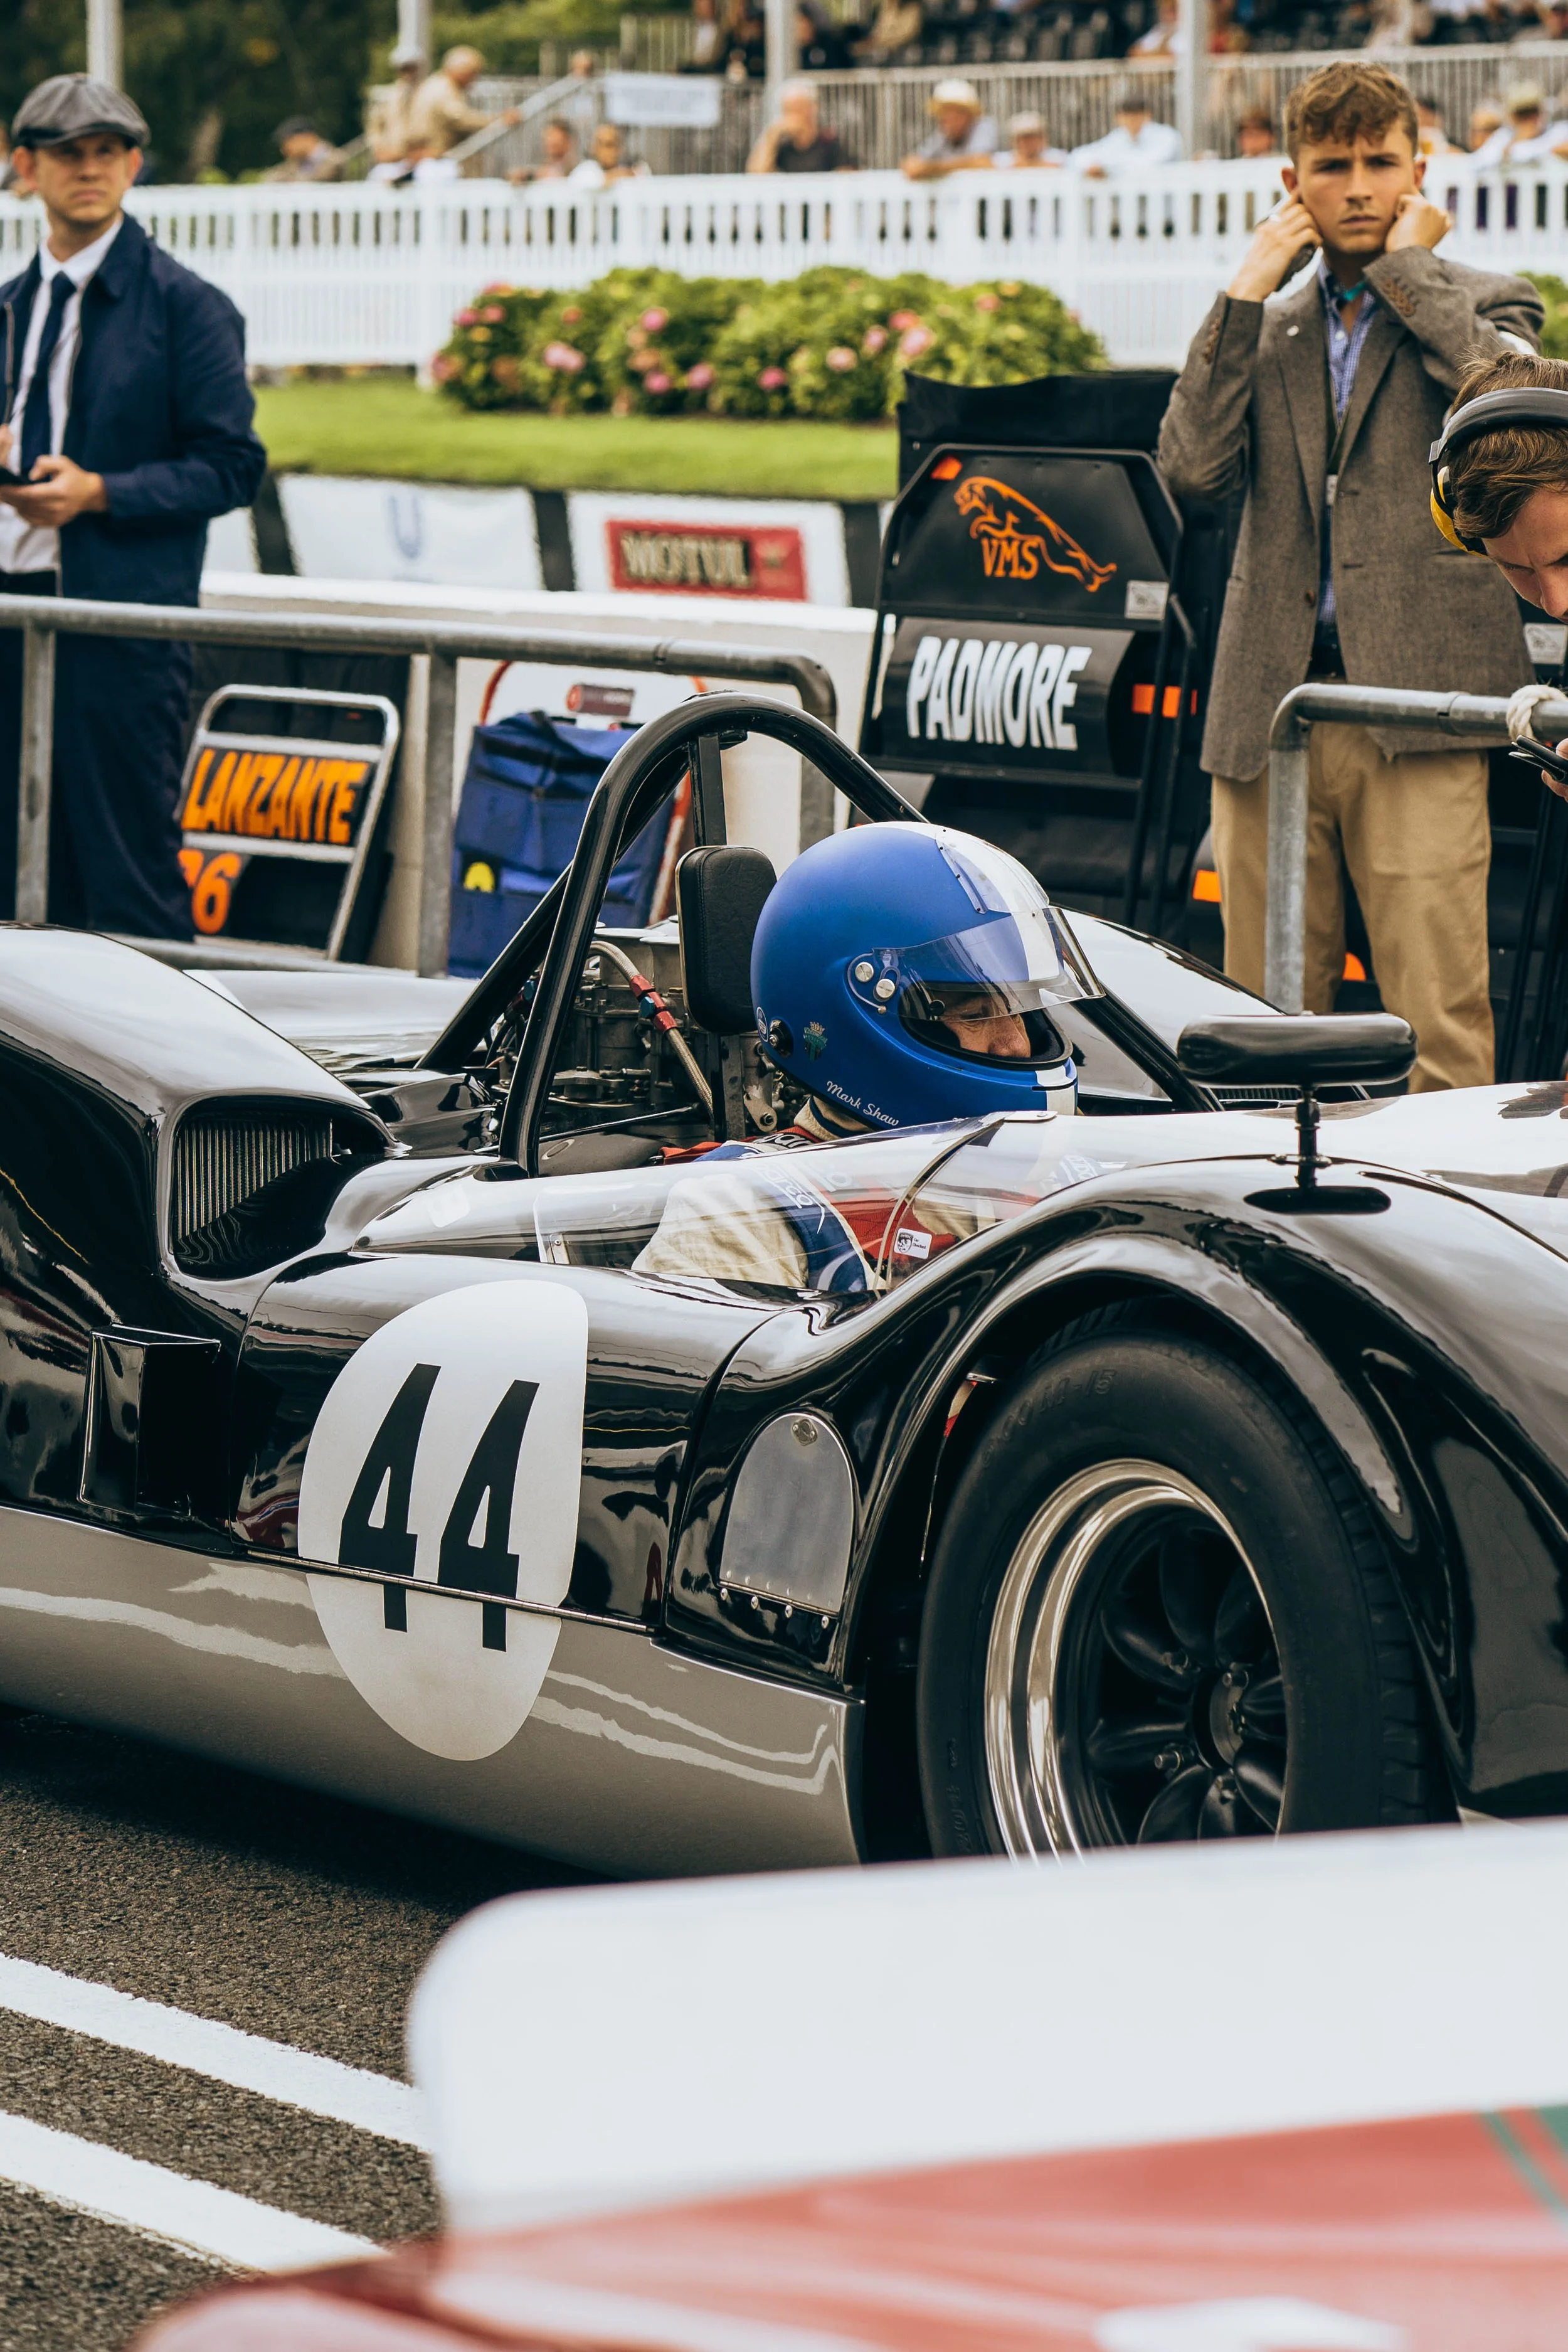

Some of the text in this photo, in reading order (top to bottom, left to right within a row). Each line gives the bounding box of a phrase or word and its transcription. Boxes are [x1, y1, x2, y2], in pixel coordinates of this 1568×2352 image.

[620, 530, 751, 588] MOTUL
[981, 537, 1039, 580] VMS
[906, 636, 1093, 751] PADMORE
[181, 748, 369, 845] LANZANTE
[827, 1080, 899, 1126] Mark Shaw
[337, 1363, 541, 1652] 44
